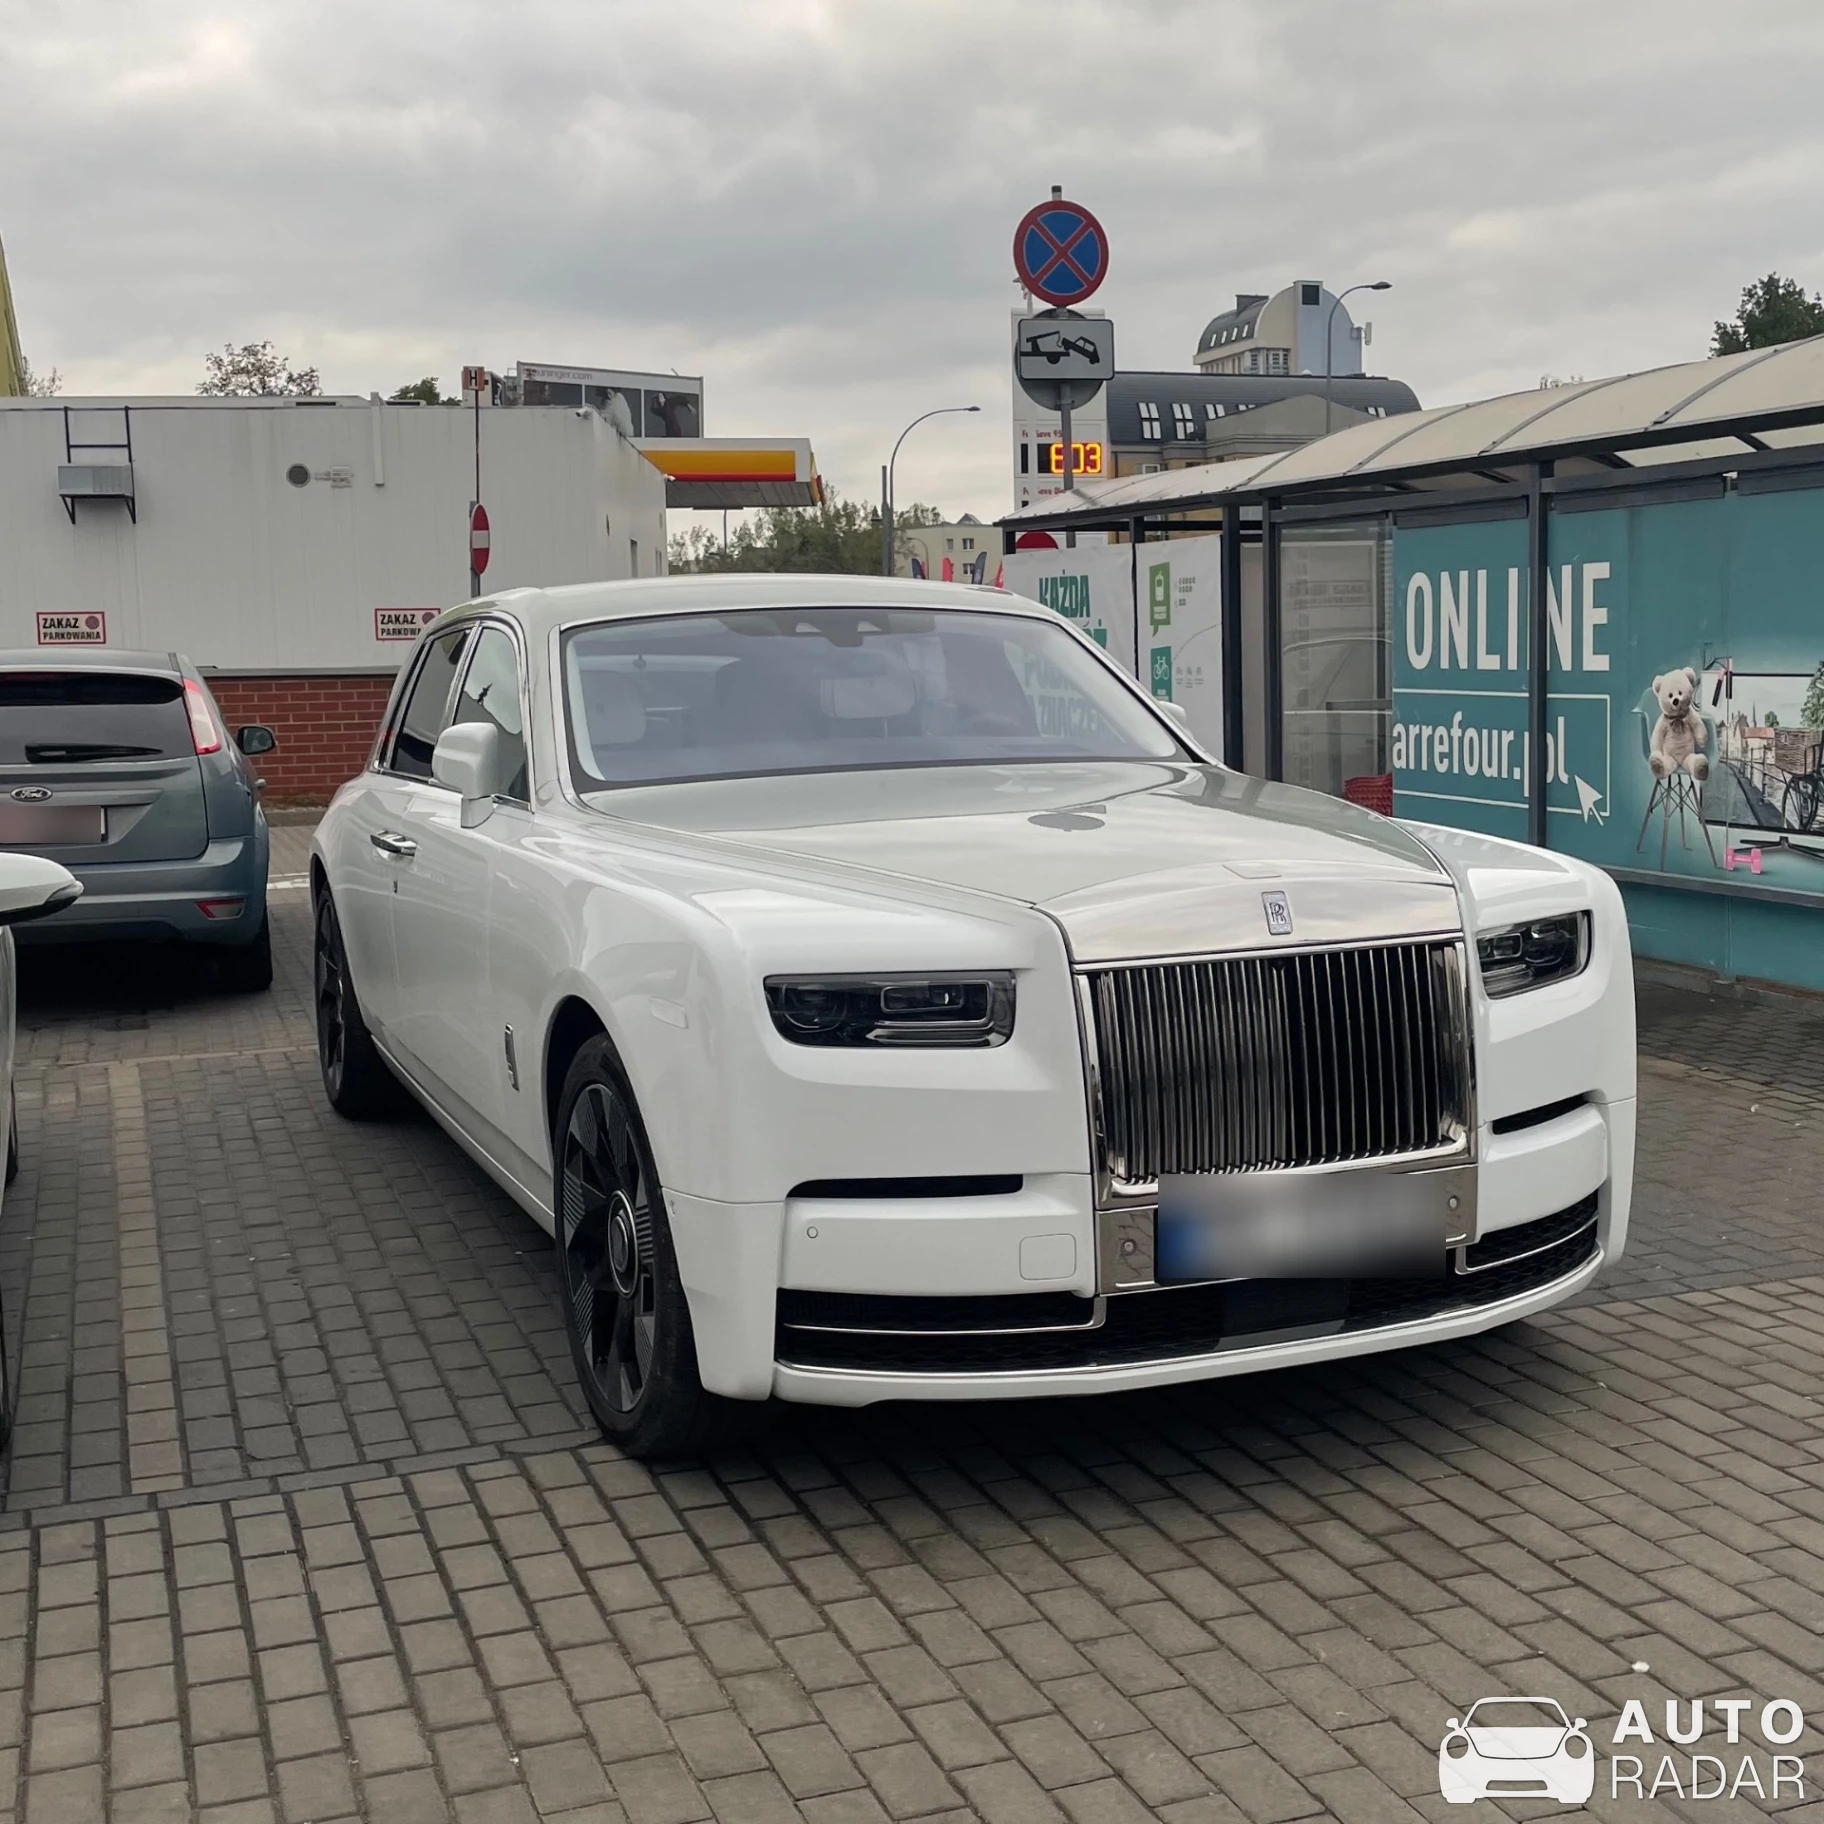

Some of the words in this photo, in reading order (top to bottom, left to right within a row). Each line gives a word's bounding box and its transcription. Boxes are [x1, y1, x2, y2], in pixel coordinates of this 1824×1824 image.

[1038, 569, 1091, 618] KAŻDA
[380, 614, 417, 625] ZAKAZ
[1406, 561, 1611, 672] ONLINE
[42, 617, 80, 629] ZAKAZ
[43, 631, 101, 640] PARKOWANIA
[381, 627, 422, 636] PARKOW
[1393, 711, 1569, 797] arrefour.pl
